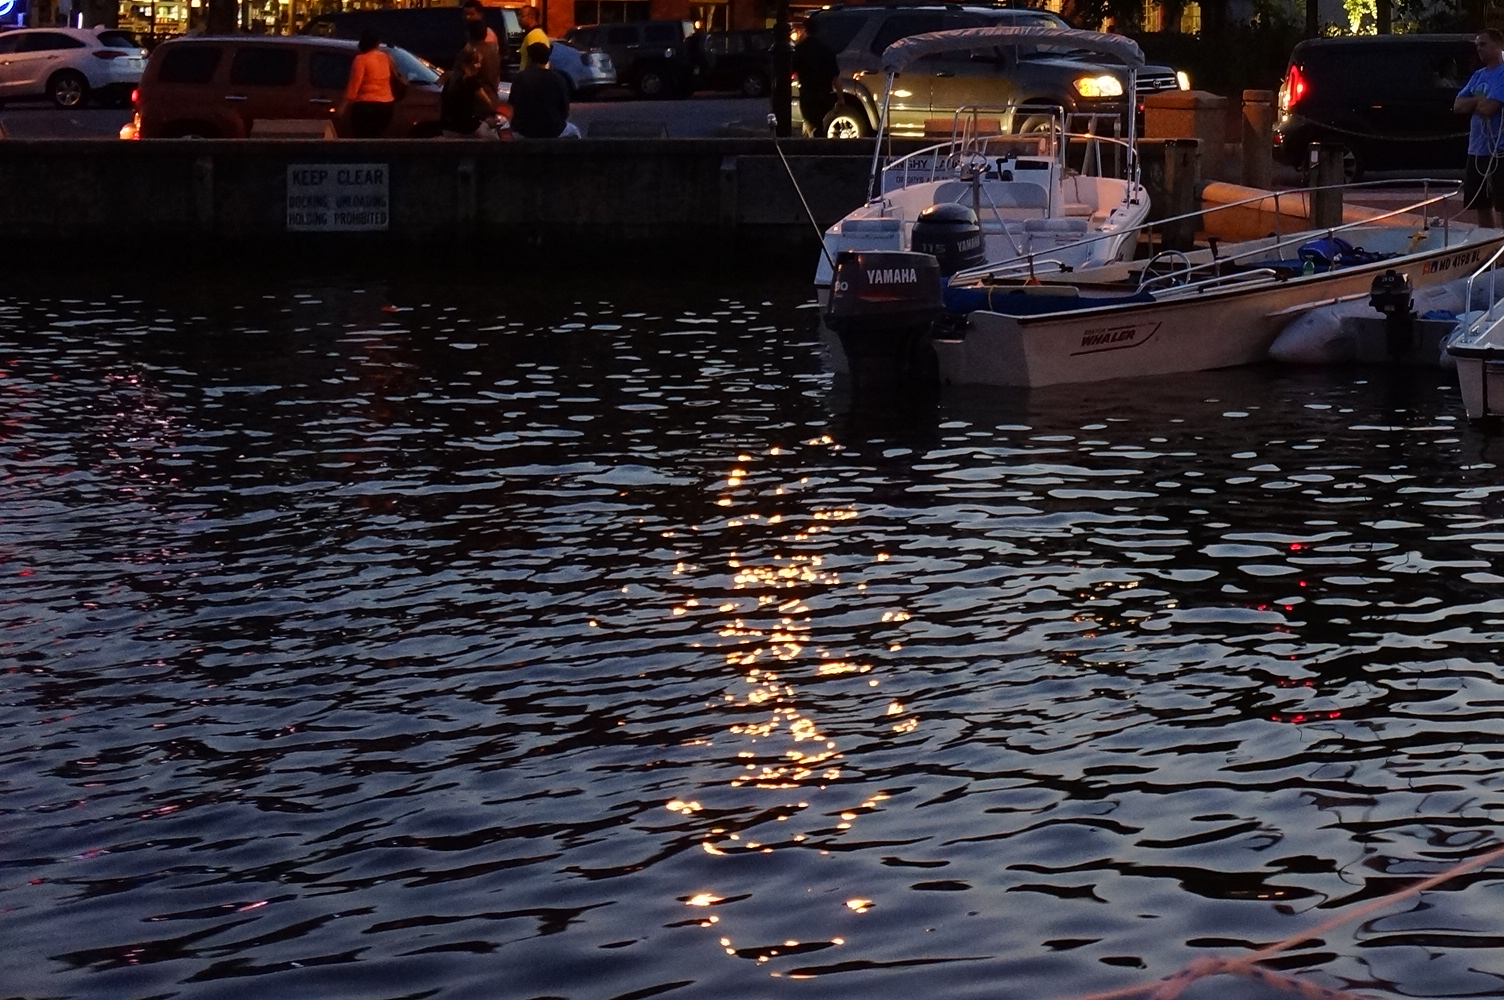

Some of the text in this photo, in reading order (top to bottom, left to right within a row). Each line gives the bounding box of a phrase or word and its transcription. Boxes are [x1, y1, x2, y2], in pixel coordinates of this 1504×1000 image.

[293, 170, 383, 186] KEEP CLEAR
[289, 212, 387, 226] HOLDING PROHIBITED
[867, 268, 918, 284] YAMAHA
[1081, 329, 1136, 347] WHALER
